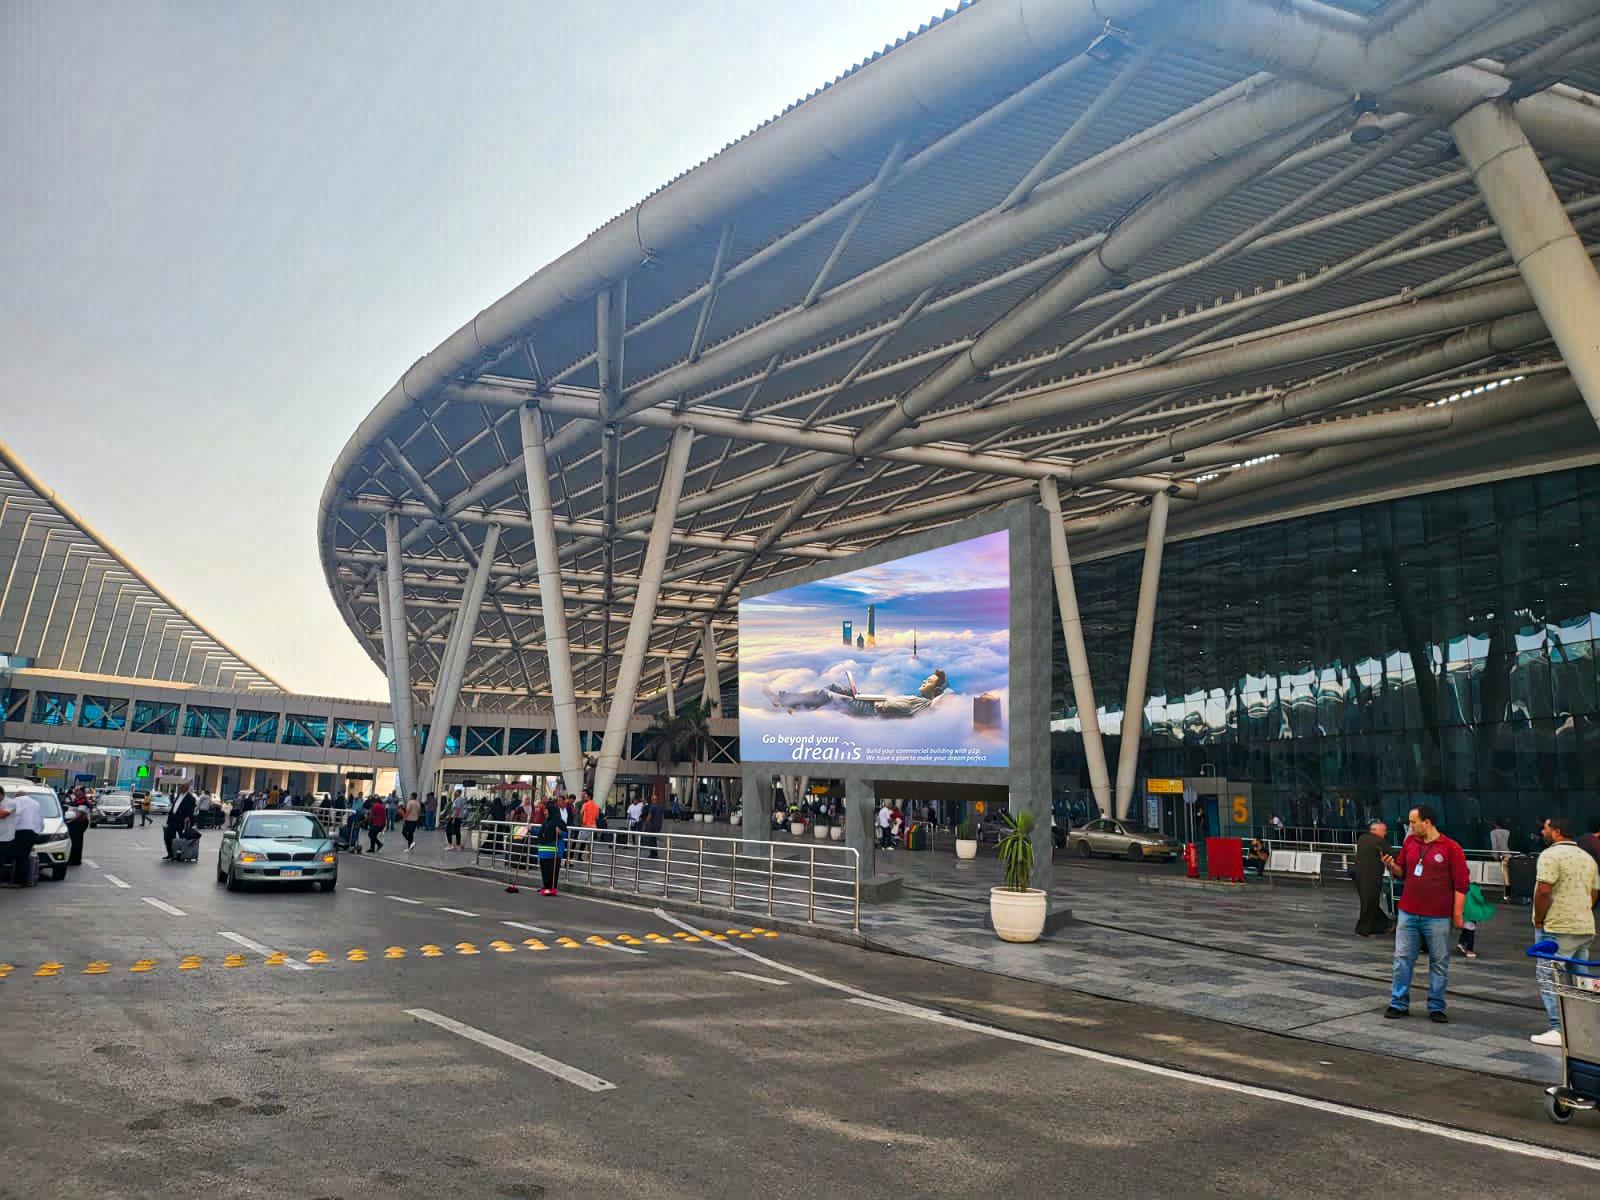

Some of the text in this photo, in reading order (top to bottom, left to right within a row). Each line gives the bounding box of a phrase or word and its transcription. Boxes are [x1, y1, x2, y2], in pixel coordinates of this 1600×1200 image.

[762, 734, 840, 746] Go beyond your
[791, 742, 862, 761] dreams
[1233, 796, 1248, 824] 5
